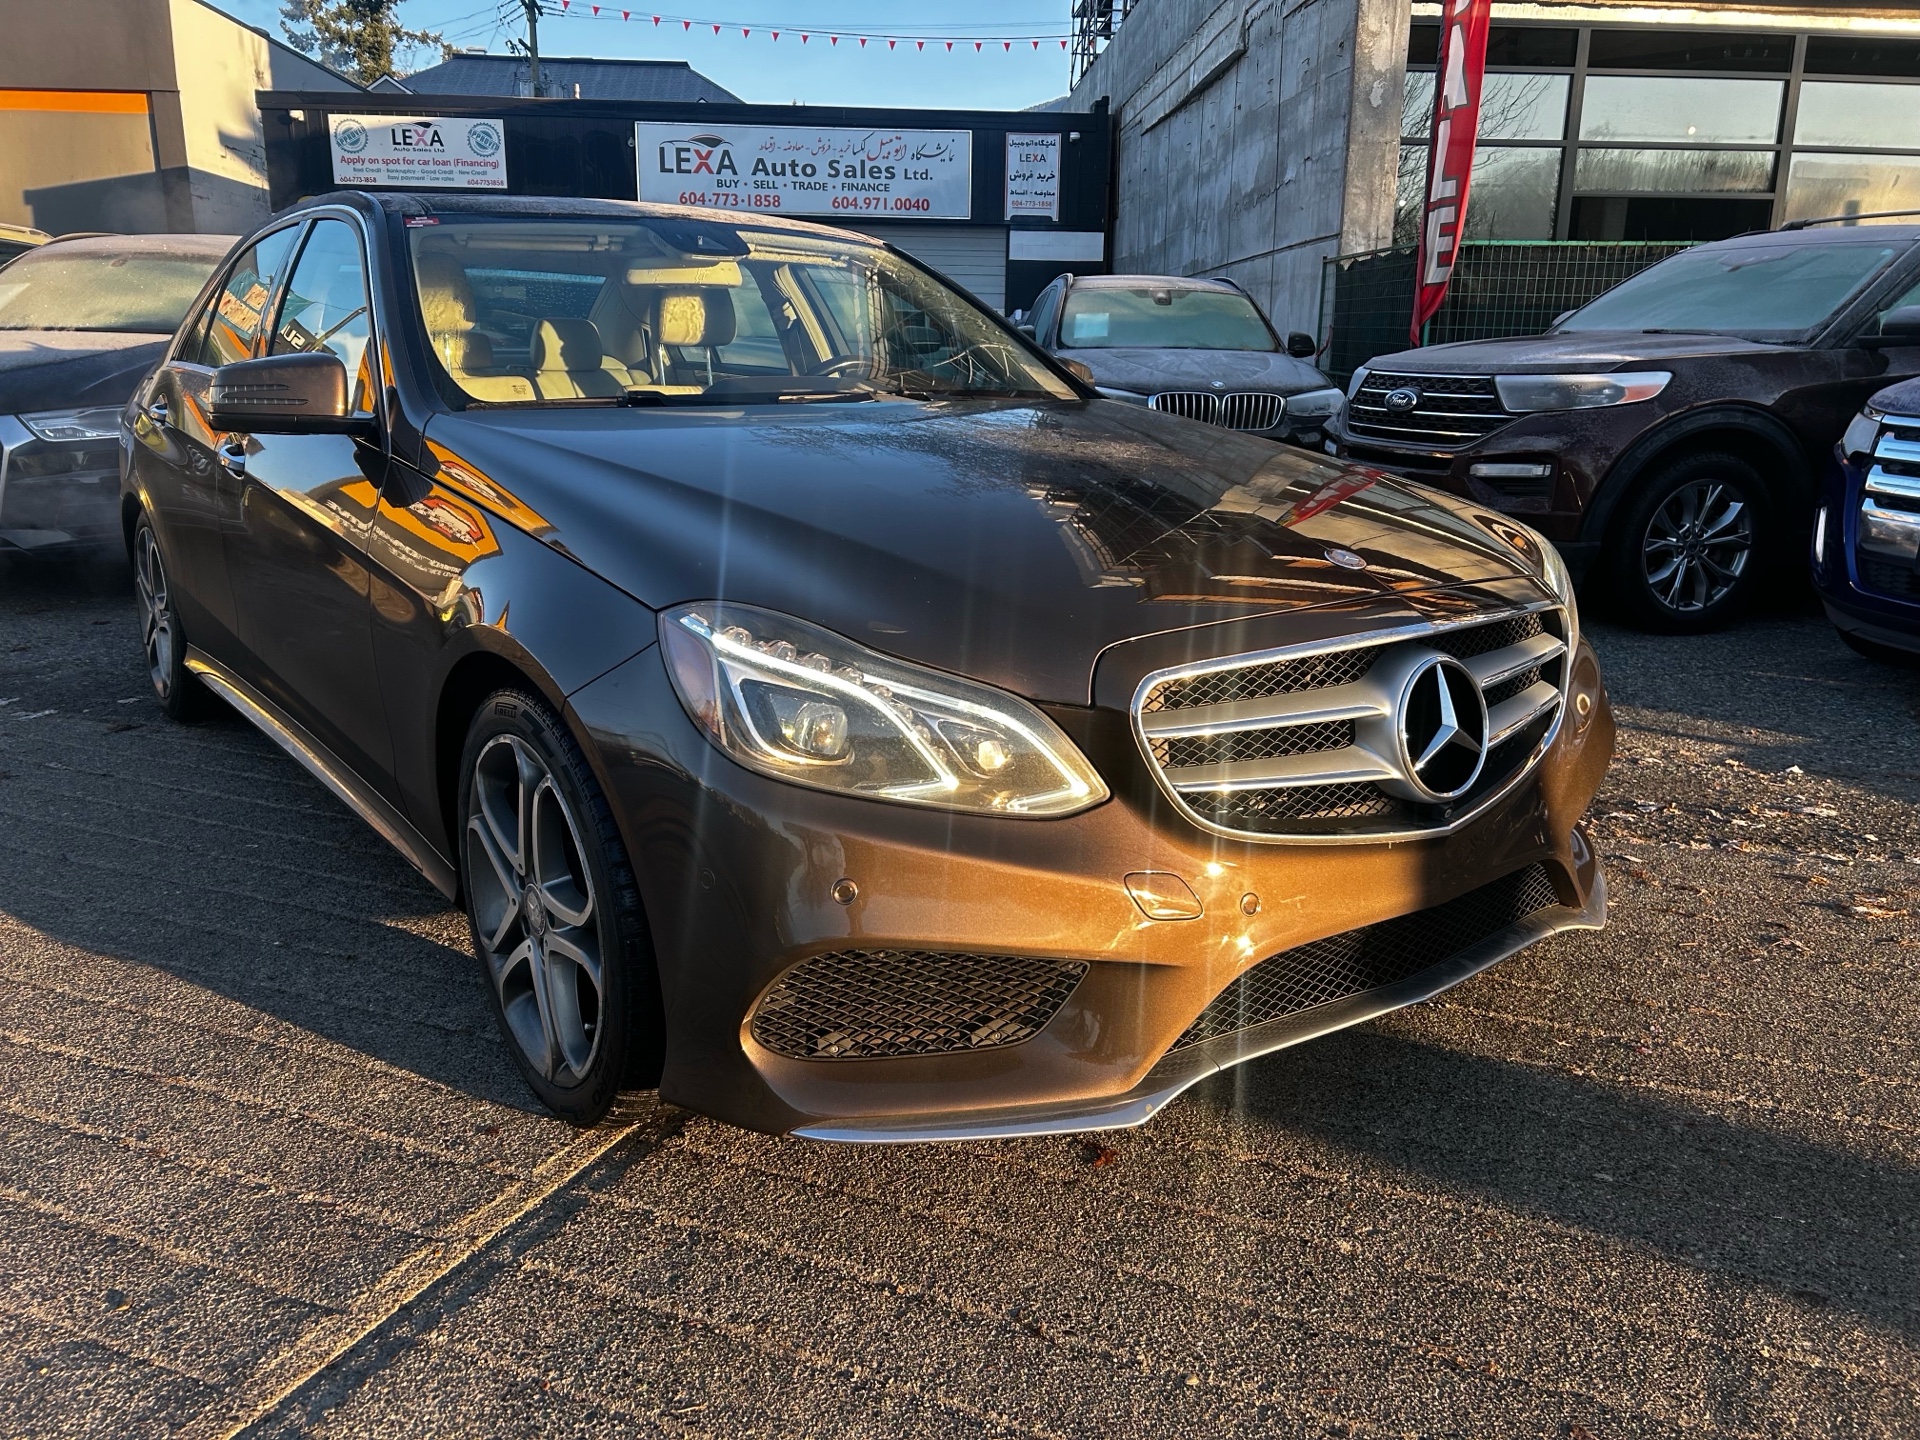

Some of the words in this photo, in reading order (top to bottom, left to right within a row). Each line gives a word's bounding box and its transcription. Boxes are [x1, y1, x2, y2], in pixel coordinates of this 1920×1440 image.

[391, 128, 445, 147] LEXA
[340, 155, 366, 166] Apply
[381, 157, 401, 166] spot
[402, 157, 415, 165] for
[432, 158, 451, 166] loan
[453, 158, 499, 169] (Financing)
[658, 147, 738, 175] LEXA
[751, 157, 817, 177] Auto
[827, 159, 896, 180] Sales
[904, 168, 933, 181] Ltd.
[1019, 153, 1047, 162] LEXA
[1009, 169, 1033, 181] فروش
[716, 179, 740, 188] BUY
[753, 180, 778, 189] SELL
[791, 181, 828, 191] TRADE
[841, 182, 890, 192] FINANCE
[832, 196, 930, 211] 604.971.0040
[494, 701, 517, 719] PIRELLI
